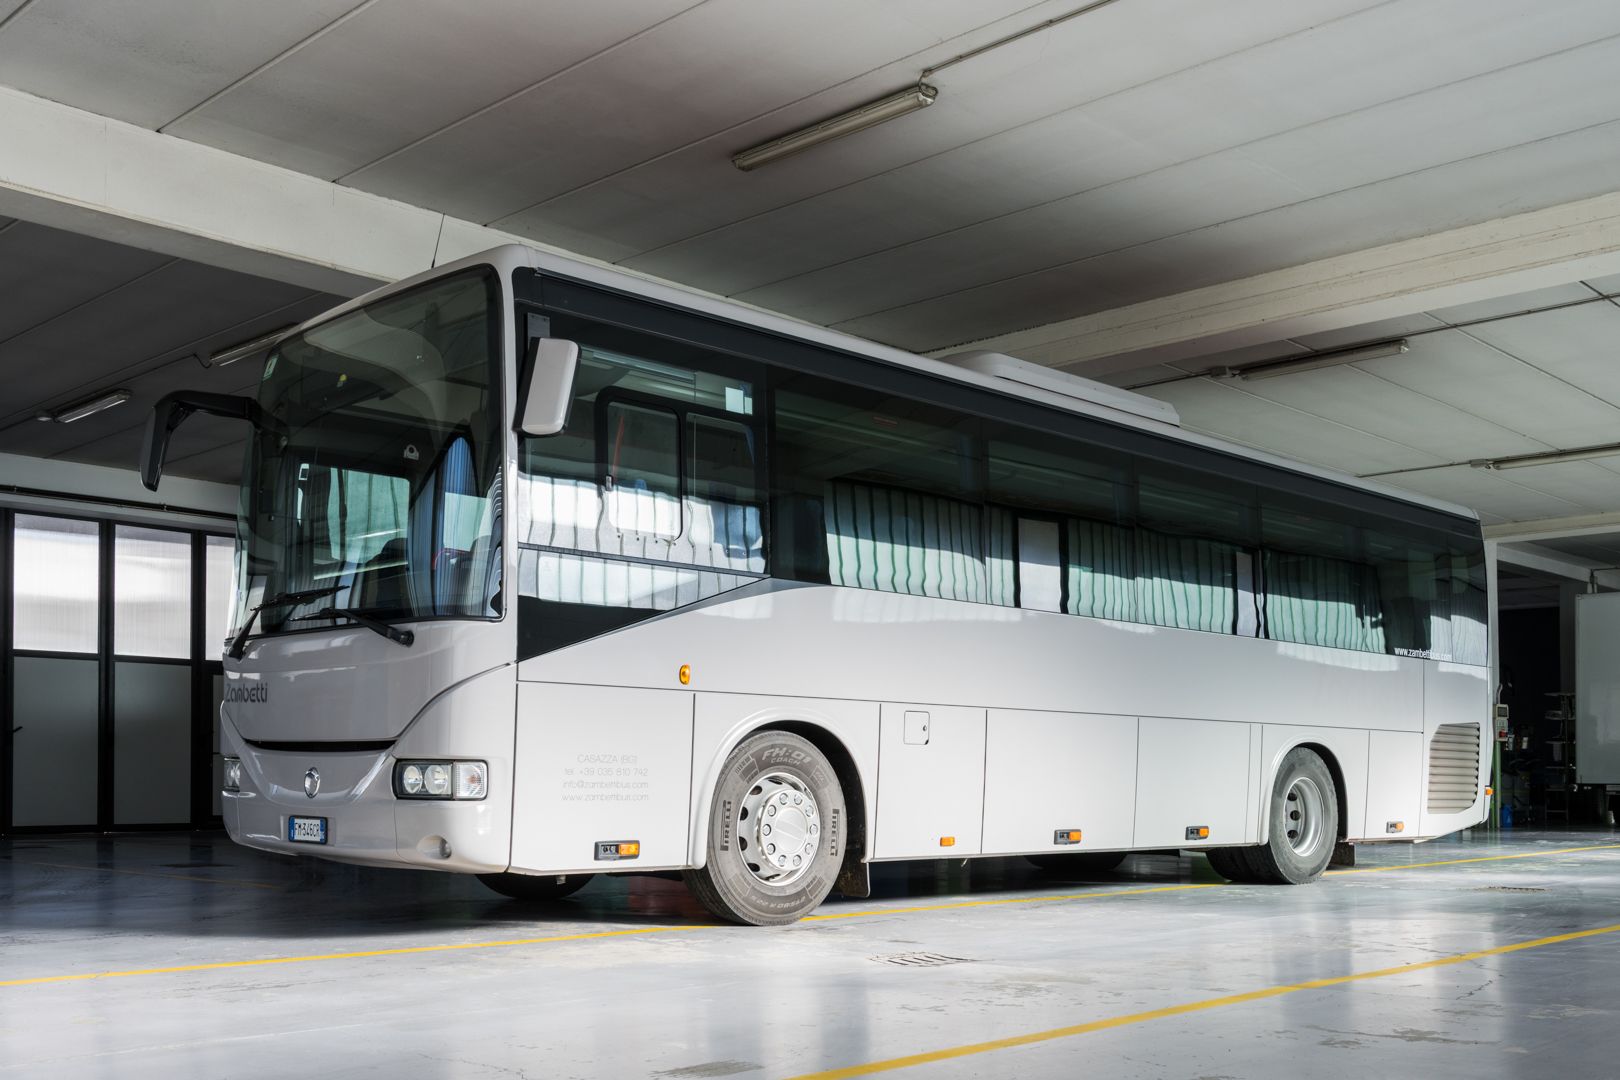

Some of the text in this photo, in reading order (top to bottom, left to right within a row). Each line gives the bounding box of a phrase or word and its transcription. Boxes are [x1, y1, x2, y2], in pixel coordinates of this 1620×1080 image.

[225, 682, 268, 703] Zambetti
[577, 753, 618, 763] CASAZZA
[597, 767, 614, 776] 035
[616, 767, 631, 776] 810
[632, 767, 649, 776] 742
[720, 800, 731, 851] PIRELLI
[830, 809, 840, 856] PIRELLI
